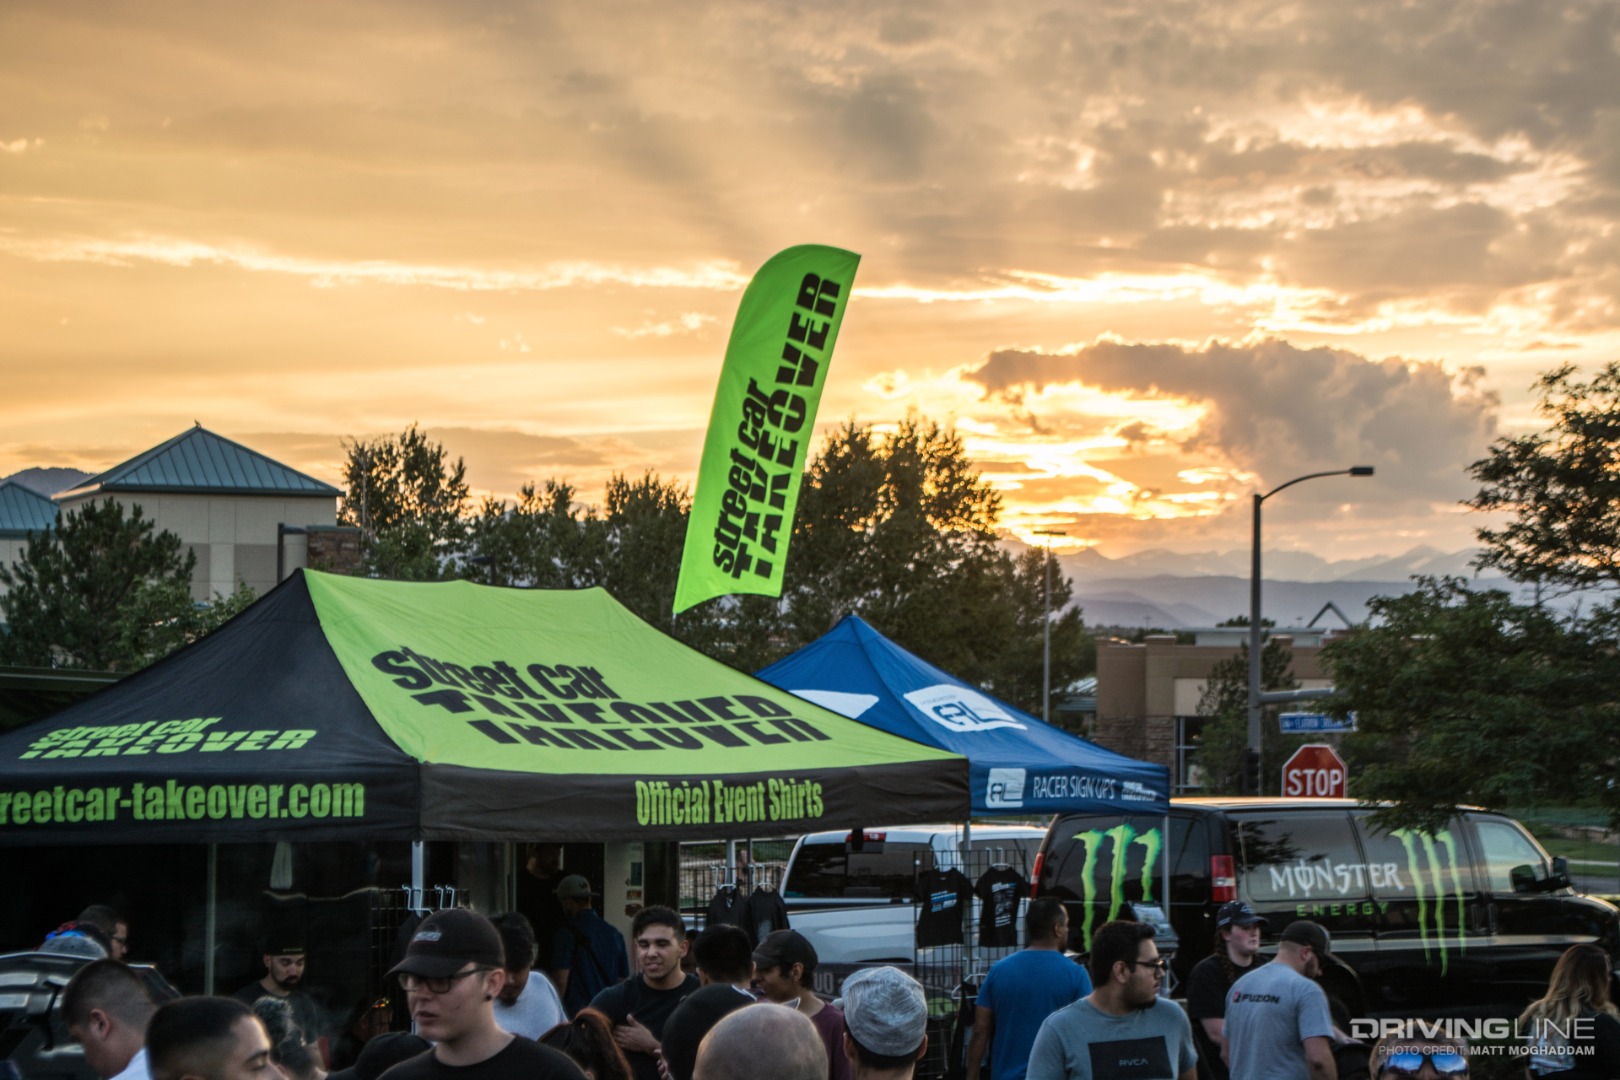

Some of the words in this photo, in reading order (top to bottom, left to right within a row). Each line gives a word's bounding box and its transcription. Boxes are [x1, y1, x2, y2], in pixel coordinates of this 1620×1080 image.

[731, 272, 841, 579] TAKEOVER
[712, 447, 757, 574] street
[737, 377, 771, 446] car
[526, 663, 622, 701] car
[39, 720, 158, 743] street
[155, 717, 223, 736] car
[410, 690, 833, 751] TAKEOVER
[18, 728, 318, 760] TAKEOVER
[1033, 776, 1069, 798] RACER
[1070, 775, 1095, 798] SIGN
[1095, 778, 1117, 800] UPS
[1287, 769, 1343, 796] STOP
[634, 780, 710, 826] Official
[712, 780, 766, 823] Event
[768, 778, 824, 821] Shirts
[1269, 858, 1405, 897] MONSTER
[1296, 902, 1389, 917] ENERGY
[1241, 993, 1281, 1005] FUZION
[1118, 1058, 1149, 1067] RVCA
